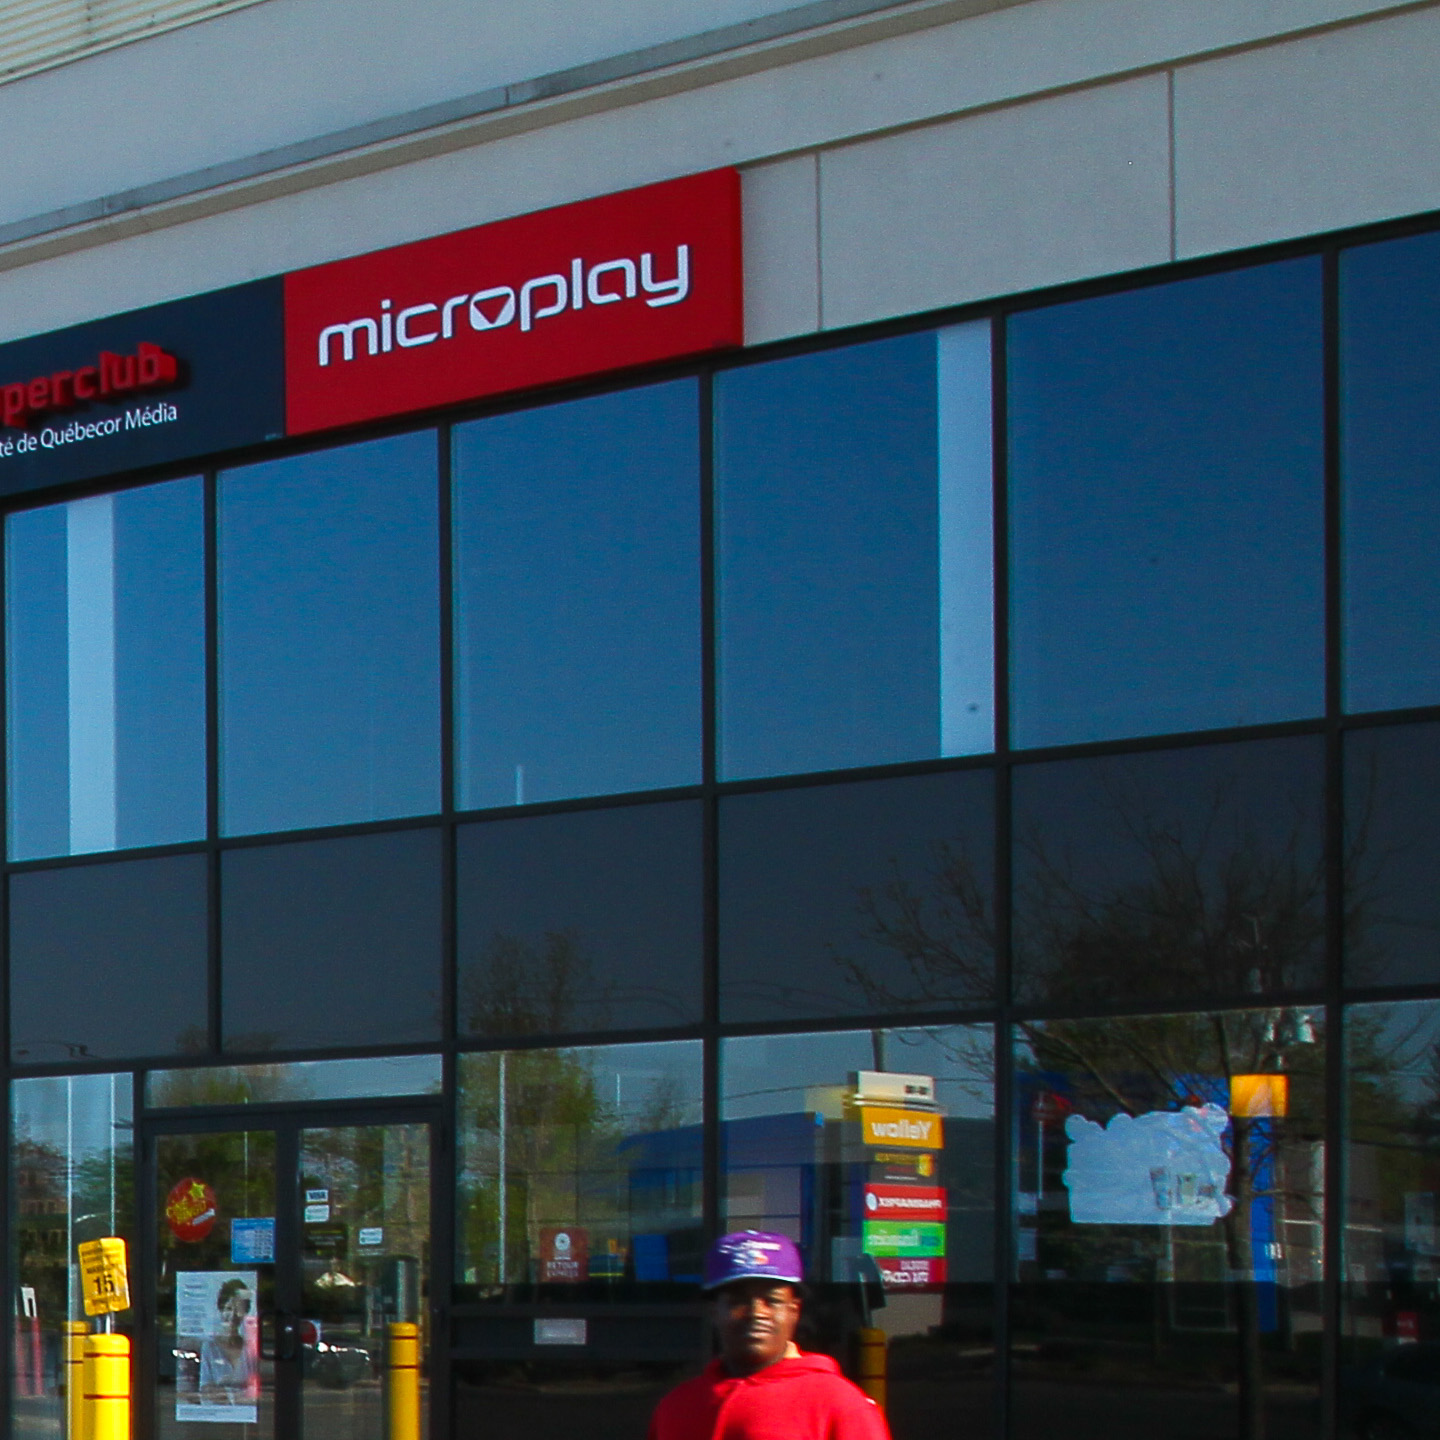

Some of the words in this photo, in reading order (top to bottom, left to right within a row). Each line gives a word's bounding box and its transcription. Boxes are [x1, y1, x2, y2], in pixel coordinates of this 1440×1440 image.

[319, 244, 689, 366] microplay
[16, 432, 38, 454] de
[40, 419, 123, 449] Québecor
[124, 402, 178, 431] Média
[93, 1274, 115, 1296] 15
